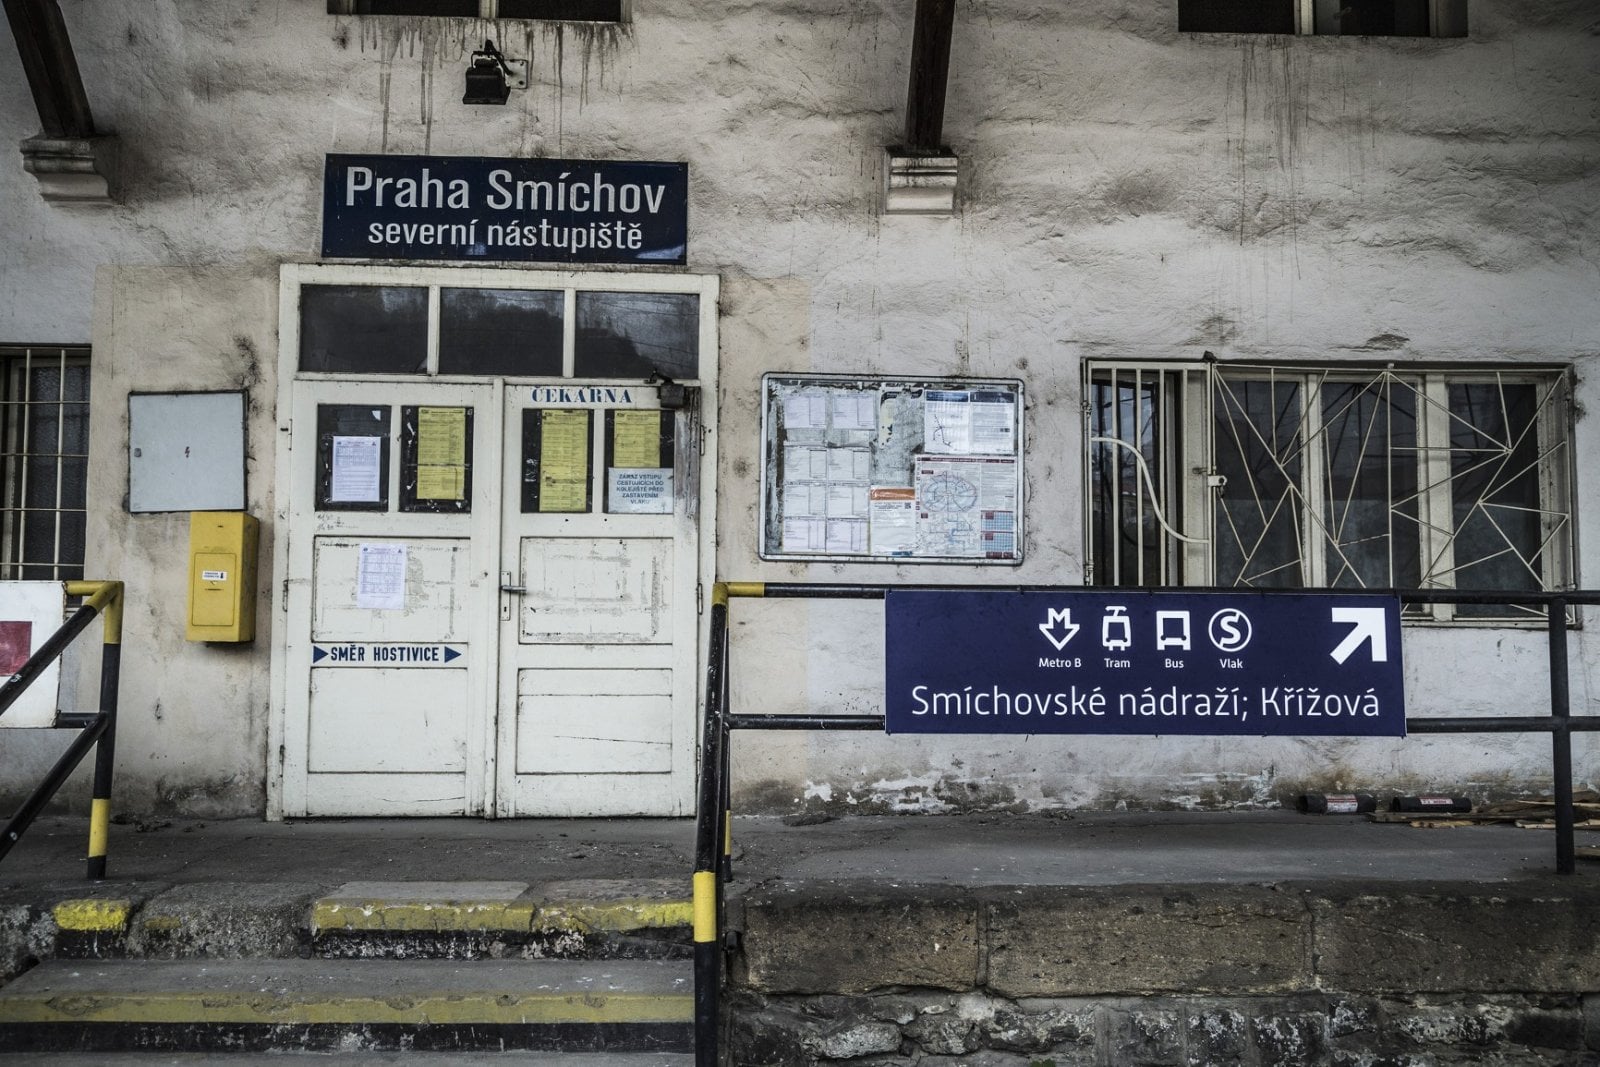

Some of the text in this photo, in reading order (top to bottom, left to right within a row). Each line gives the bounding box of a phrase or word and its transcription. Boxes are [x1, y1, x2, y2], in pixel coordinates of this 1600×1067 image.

[346, 166, 666, 214] Praha Smíchov
[368, 218, 642, 254] severní nástupiště
[331, 644, 440, 662] SMĚR HOSTIVICE
[1038, 657, 1082, 668] Metro B
[1104, 657, 1131, 668] Tram
[1165, 658, 1184, 669] Bus
[1220, 658, 1243, 669] Vlak
[911, 685, 1379, 721] Smíchovské nádraží; Křížová
